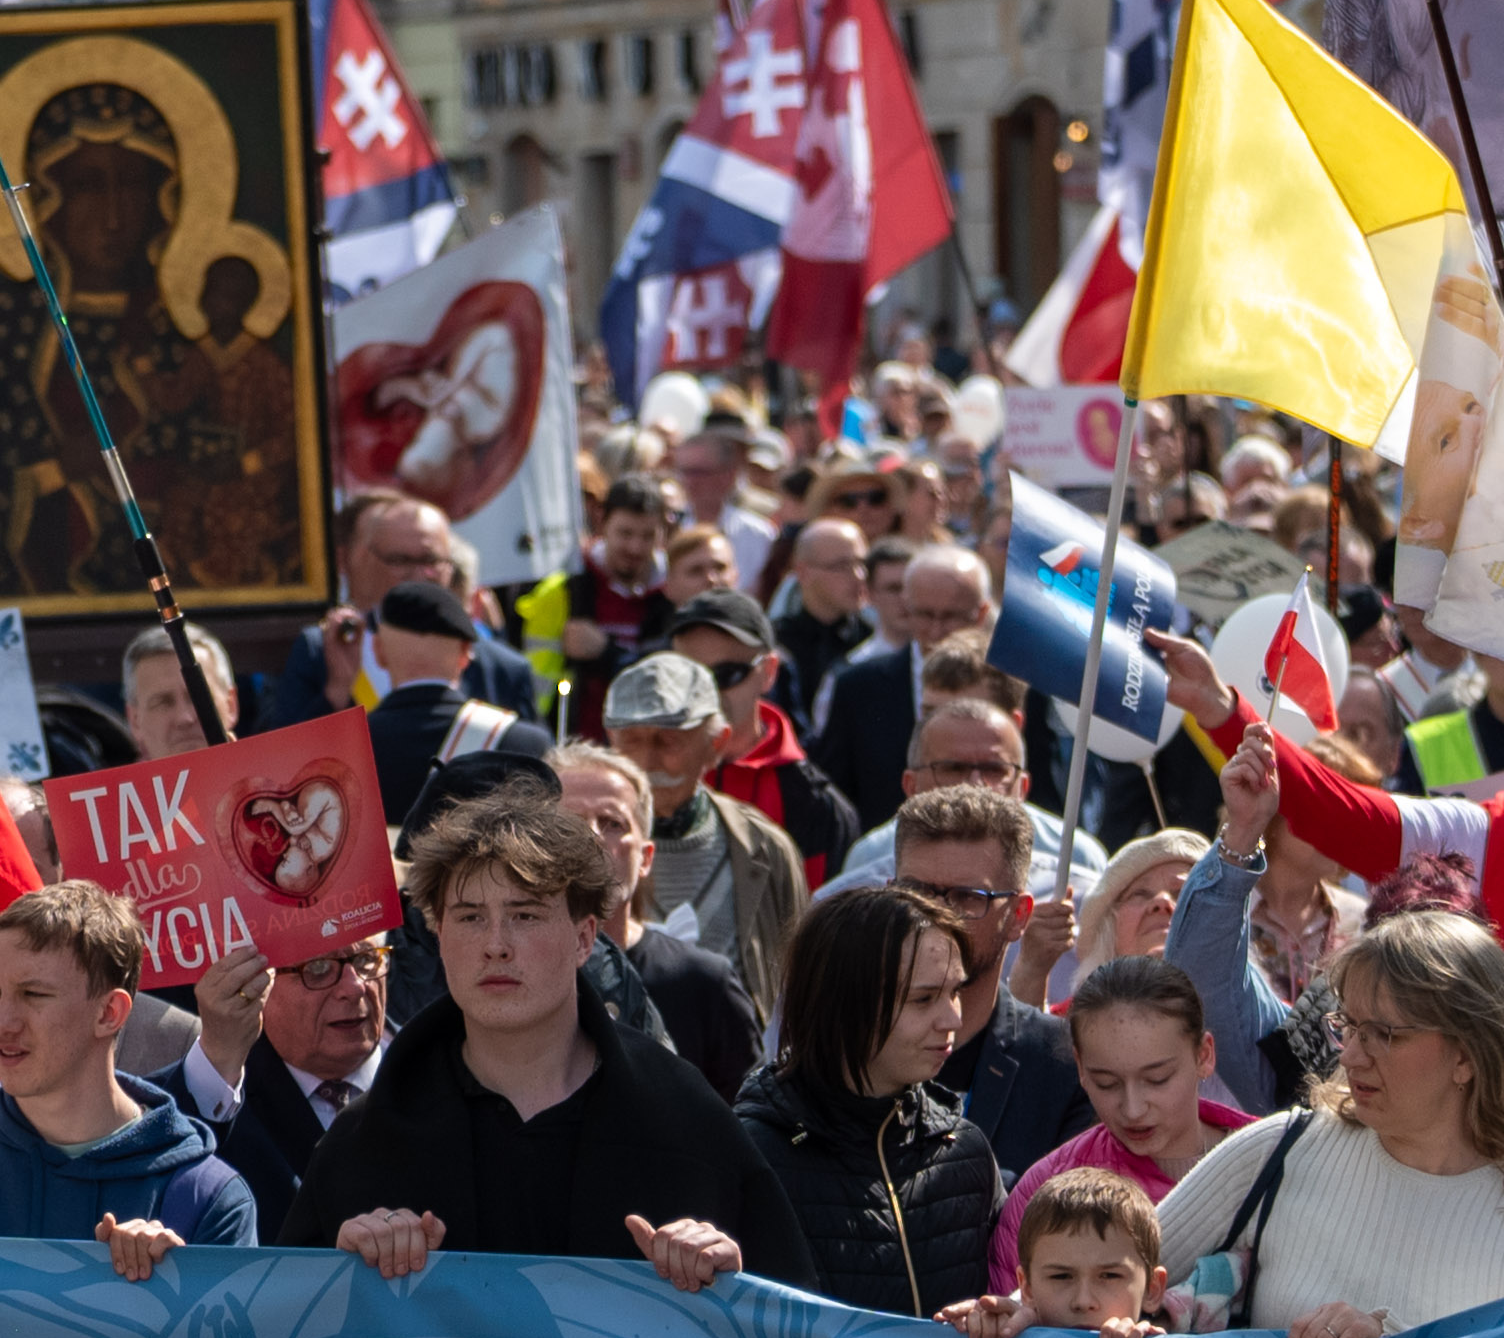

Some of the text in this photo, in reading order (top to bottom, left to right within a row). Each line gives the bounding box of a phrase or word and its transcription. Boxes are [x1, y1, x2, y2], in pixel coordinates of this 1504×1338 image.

[69, 769, 205, 864] TAK
[122, 858, 202, 913] dla
[341, 901, 383, 921] KOALICJA
[140, 896, 255, 974] YCIA
